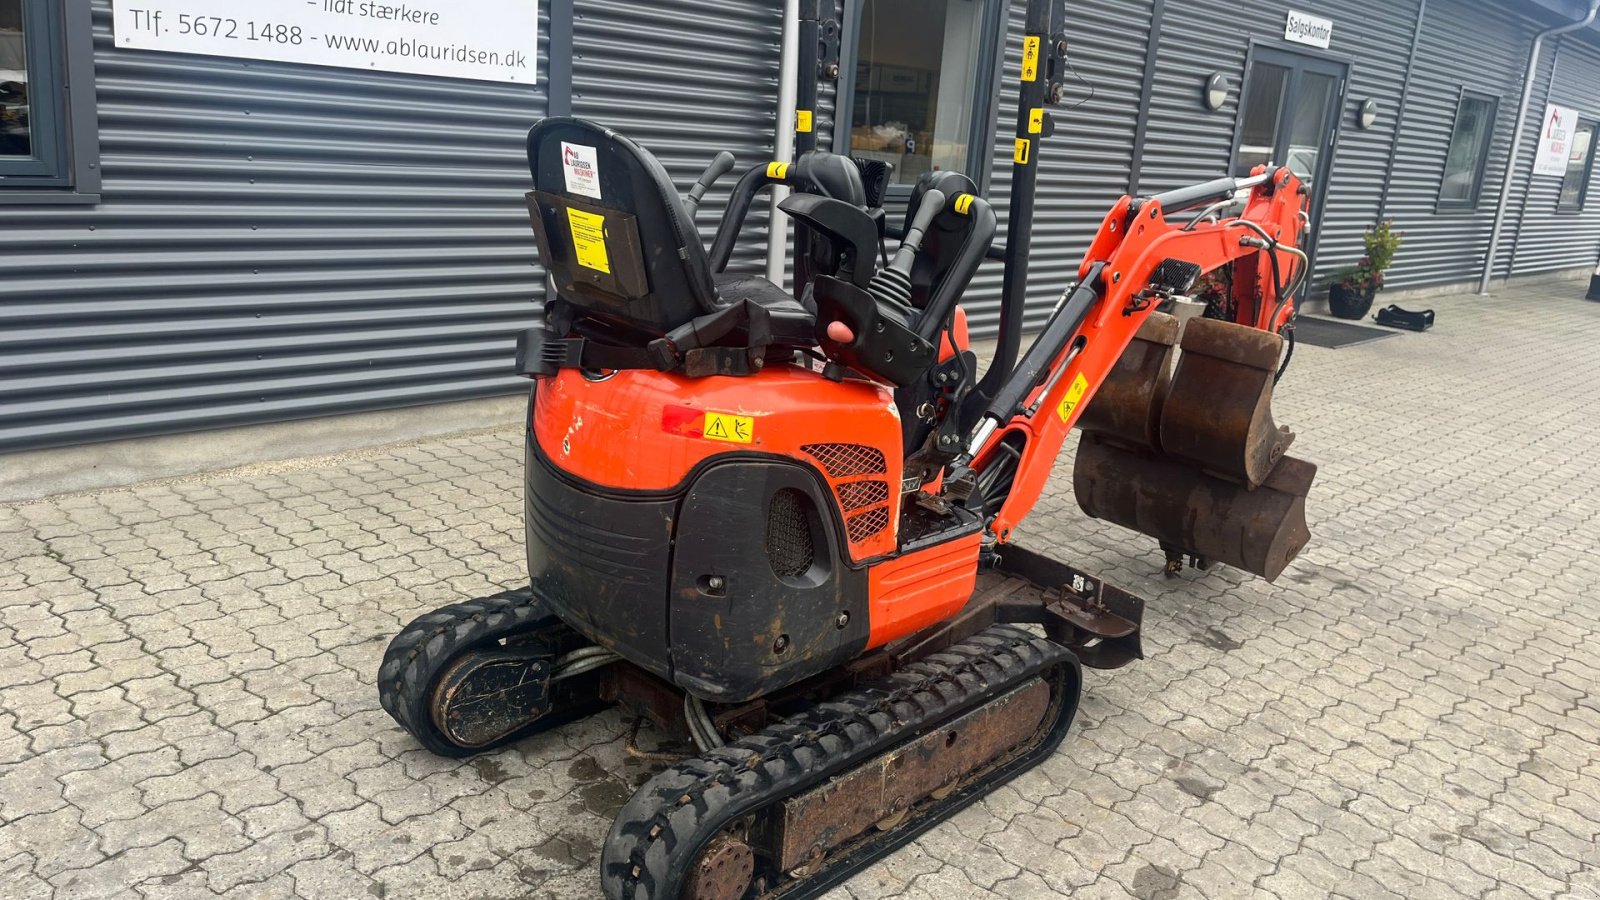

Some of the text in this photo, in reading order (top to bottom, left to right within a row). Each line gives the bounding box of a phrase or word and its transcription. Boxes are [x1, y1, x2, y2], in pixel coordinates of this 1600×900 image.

[359, 2, 440, 26] stærkere
[129, 9, 169, 37] Tlf.
[179, 14, 239, 39] 5672
[246, 21, 303, 45] 1488
[325, 34, 527, 68] www.ablauridsen.dk
[1289, 16, 1330, 40] Salgskontor
